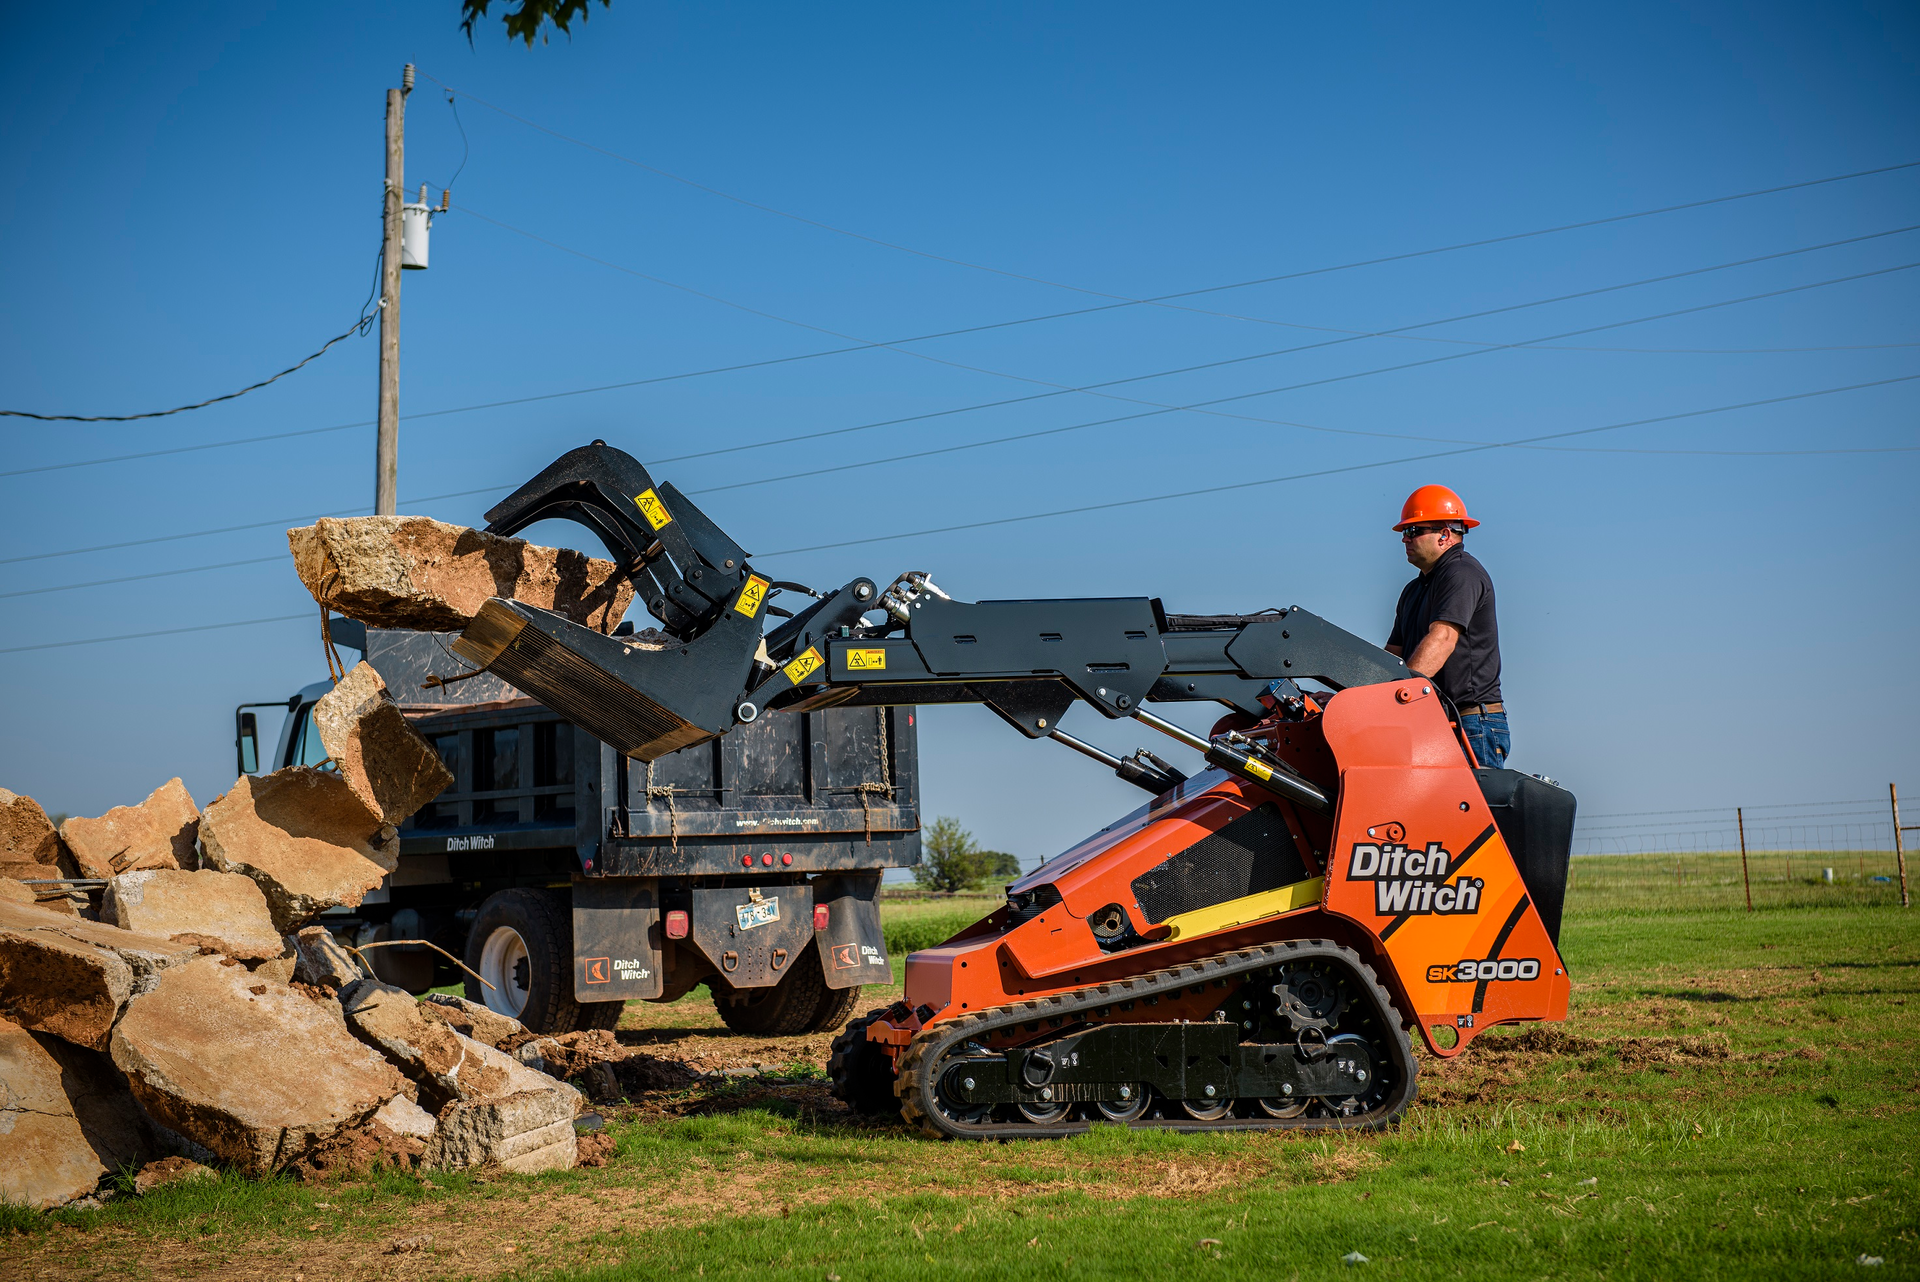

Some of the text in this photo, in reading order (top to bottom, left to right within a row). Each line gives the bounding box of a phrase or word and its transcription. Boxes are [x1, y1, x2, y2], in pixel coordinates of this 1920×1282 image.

[736, 817, 819, 826] www.chwitch.com
[447, 836, 469, 852] Ditch
[1350, 844, 1449, 877] Ditch
[861, 945, 878, 955] Ditch
[614, 958, 640, 970] Ditch
[1428, 960, 1540, 980] SK3000
